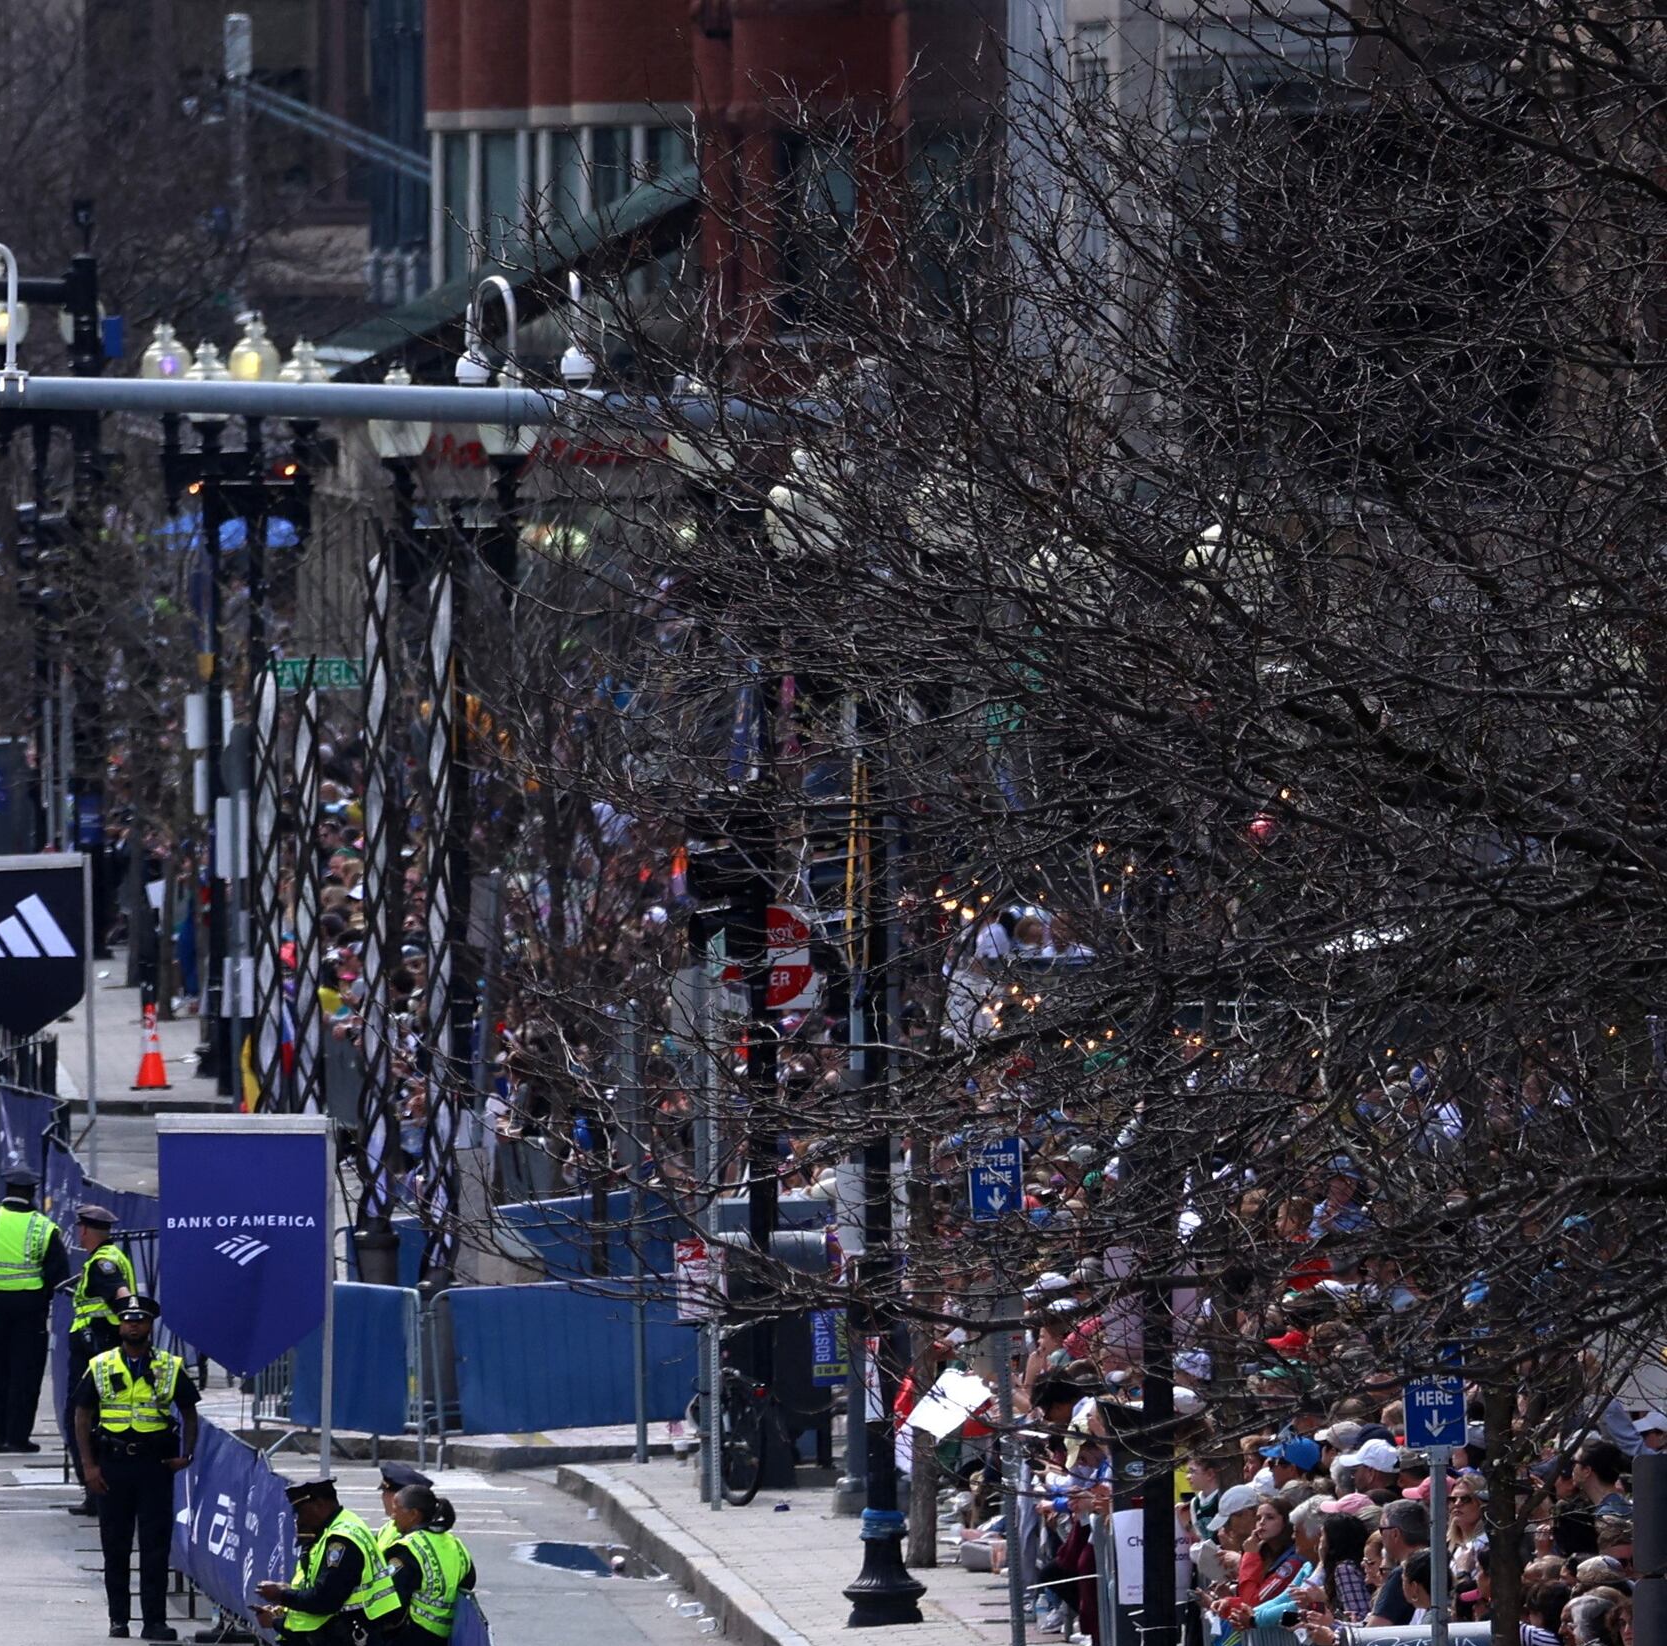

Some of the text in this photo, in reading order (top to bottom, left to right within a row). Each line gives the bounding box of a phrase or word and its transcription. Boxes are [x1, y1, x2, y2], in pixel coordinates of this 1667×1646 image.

[167, 1216, 316, 1229] BANK OF AMERICA
[1415, 1391, 1455, 1407] HERE
